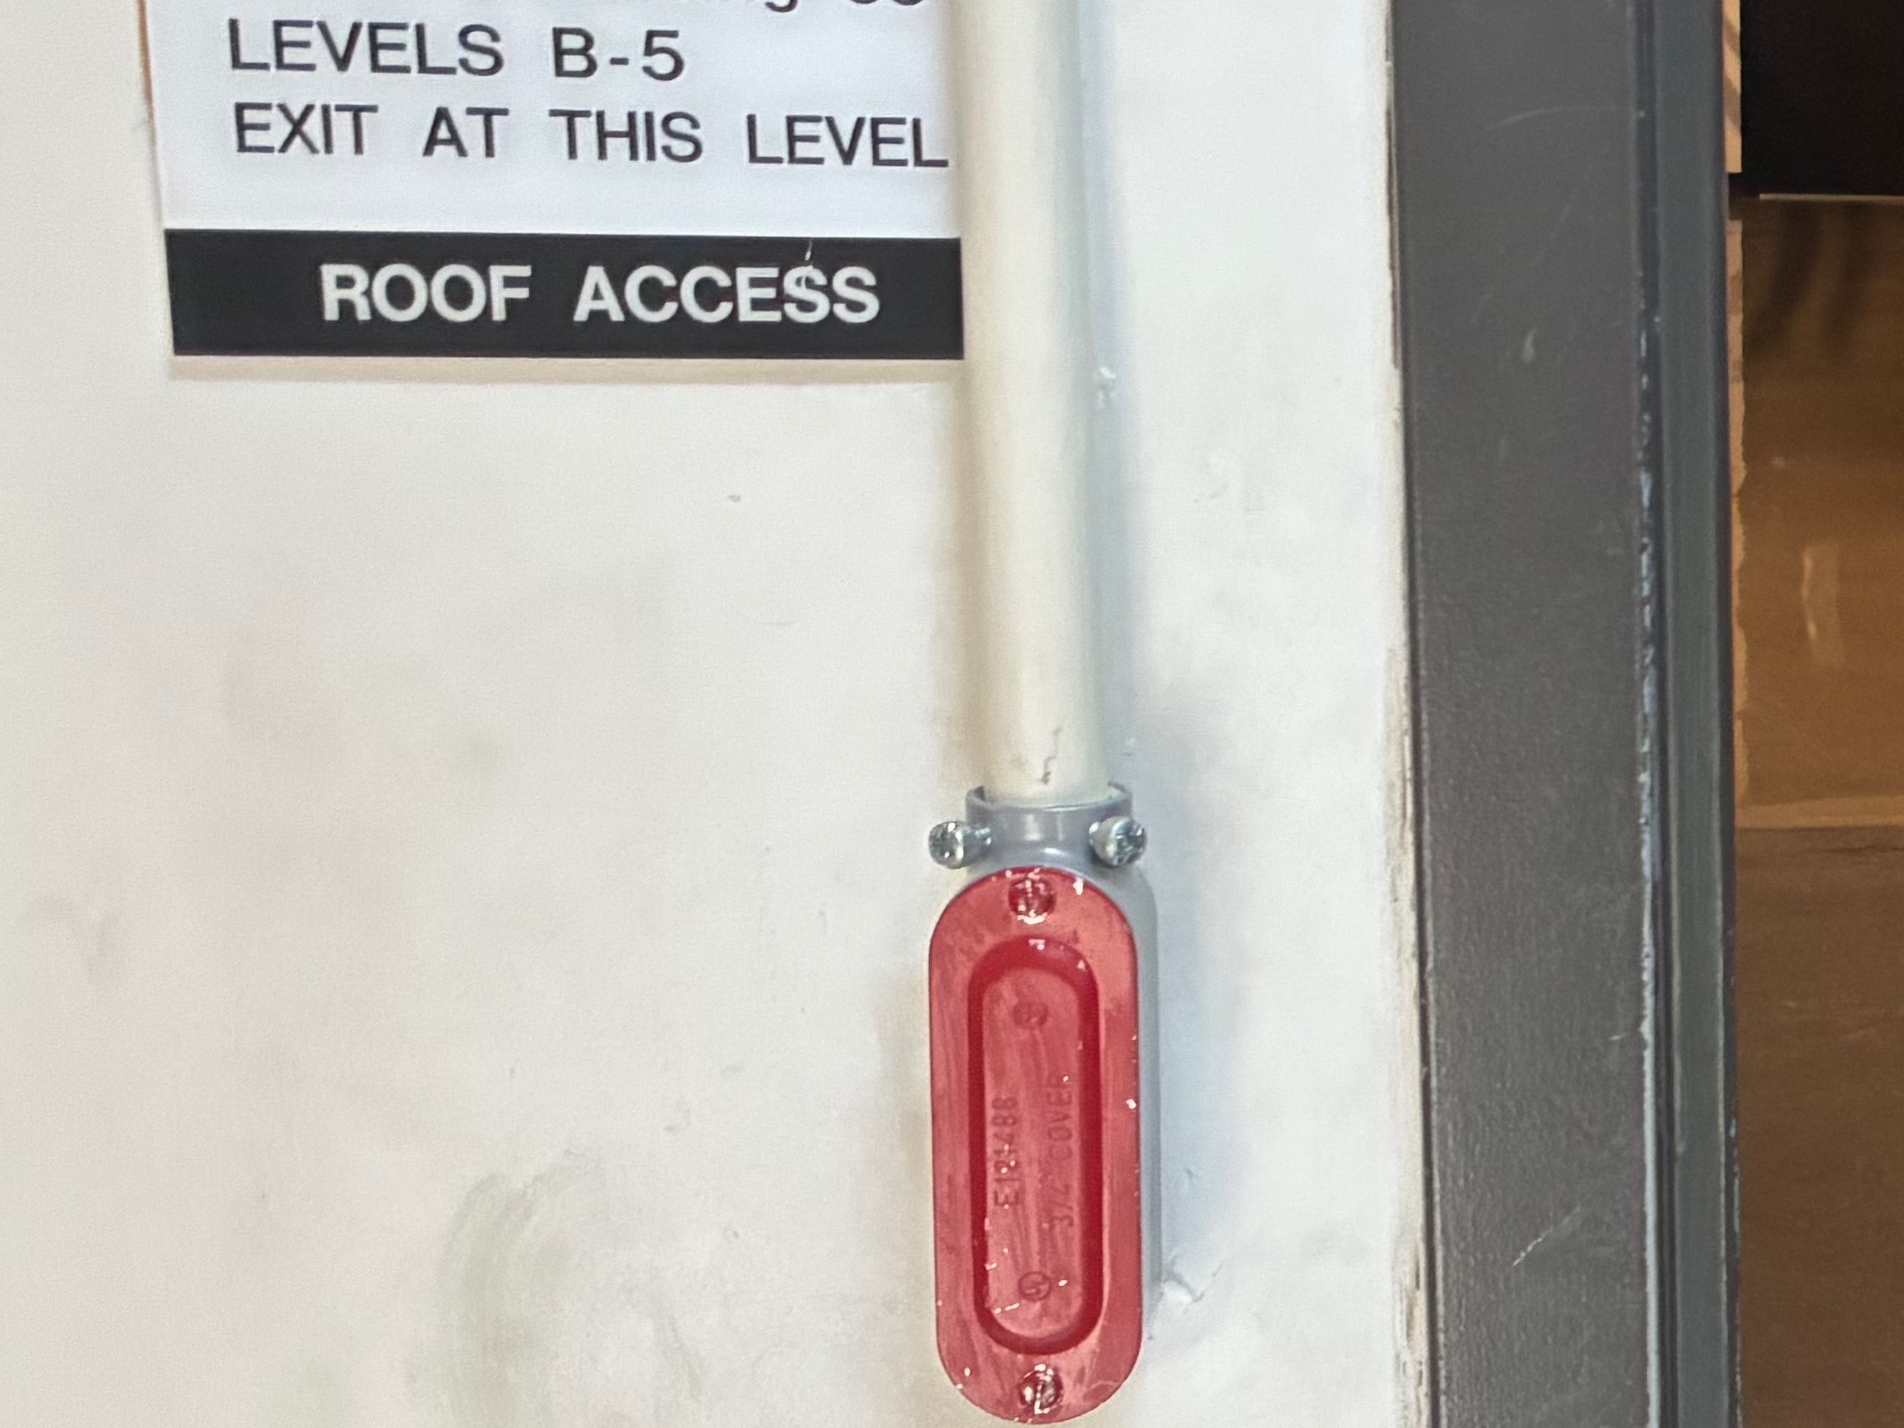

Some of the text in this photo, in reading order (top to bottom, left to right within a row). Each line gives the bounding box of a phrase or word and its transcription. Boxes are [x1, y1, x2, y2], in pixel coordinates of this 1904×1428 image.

[229, 18, 684, 81] LEVELS B-5
[235, 102, 949, 167] EXIT AT THIS LEVEL
[321, 264, 879, 323] ROOF ACCESS
